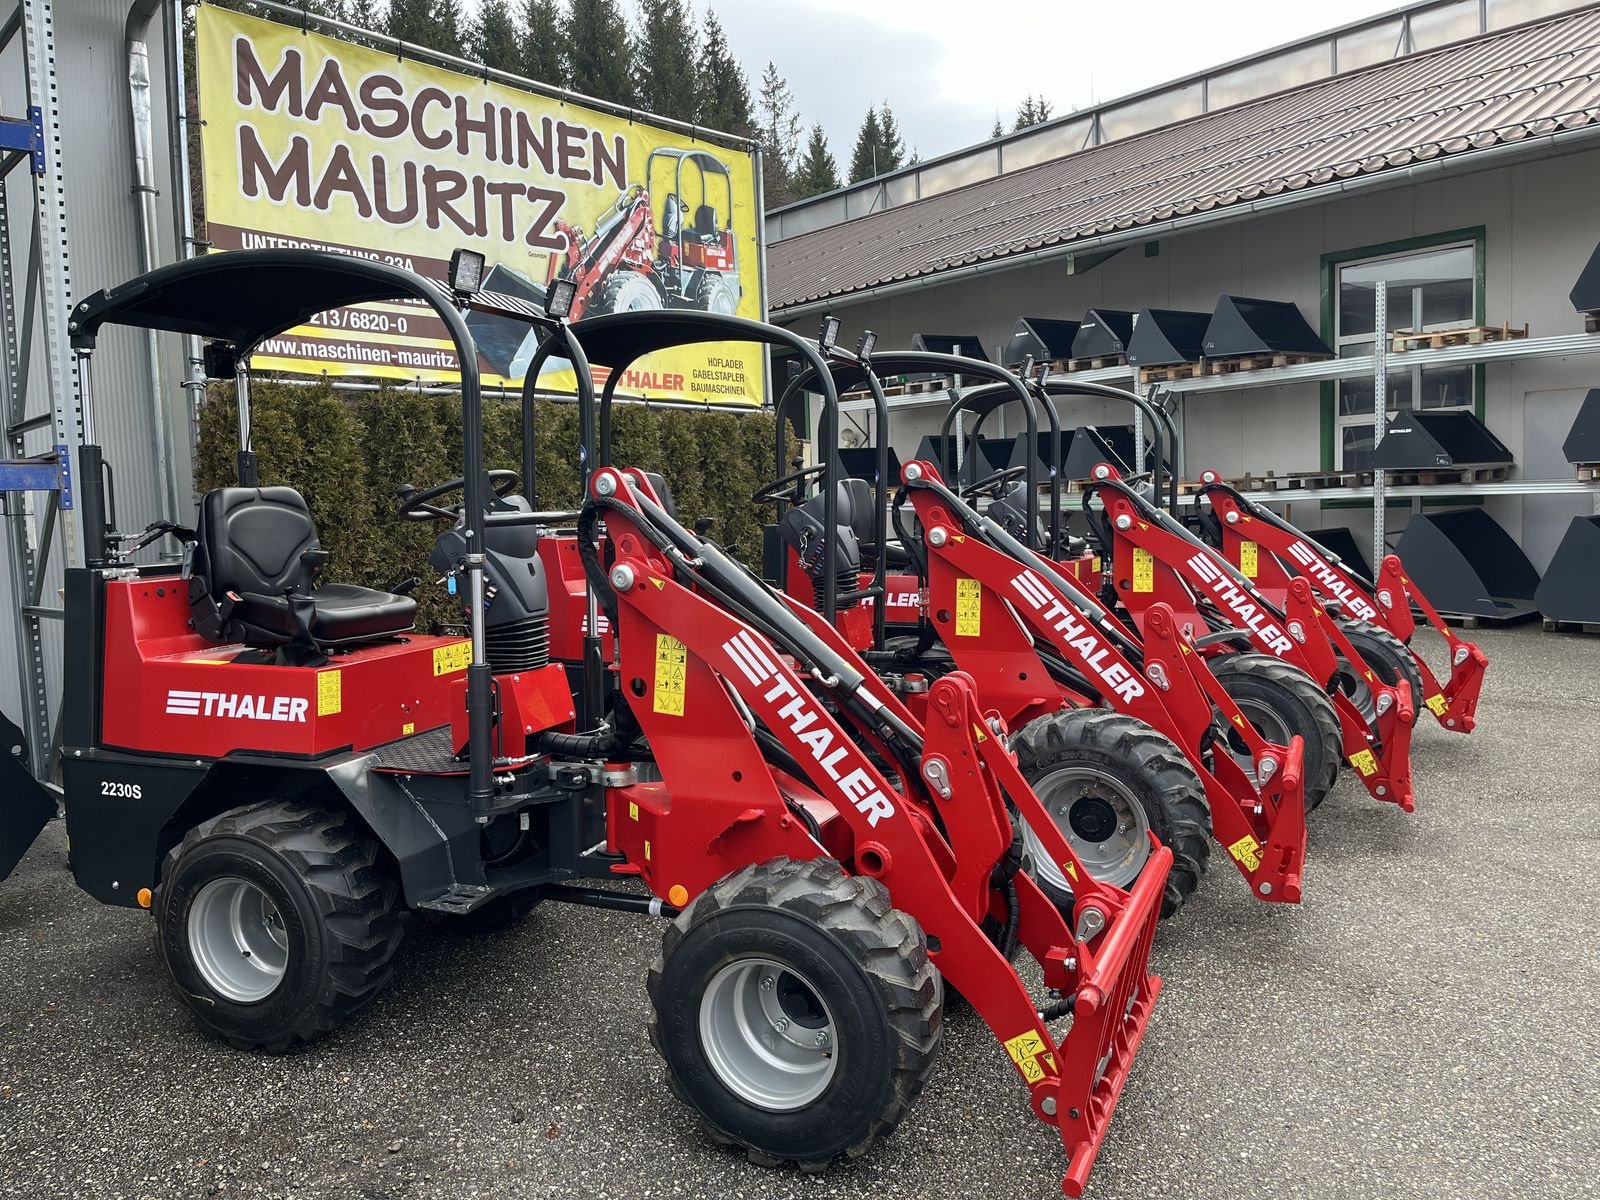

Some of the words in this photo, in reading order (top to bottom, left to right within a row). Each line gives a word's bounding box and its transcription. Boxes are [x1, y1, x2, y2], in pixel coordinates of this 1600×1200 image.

[236, 37, 627, 190] MASCHINEN
[239, 125, 568, 251] MAURITZ
[253, 339, 460, 369] ww.maschinen-mauritz.
[708, 357, 744, 369] HOFLADER
[618, 369, 684, 391] THALER
[691, 383, 745, 395] BAUMASCHINEN
[692, 369, 745, 382] GABELSTAPLER
[861, 592, 921, 608] HLER
[1307, 556, 1377, 622] THALER
[1210, 578, 1293, 657] THALER
[1040, 598, 1146, 705] THALER
[201, 692, 309, 723] THALER
[763, 673, 896, 829] THALER
[100, 781, 142, 800] 2230S
